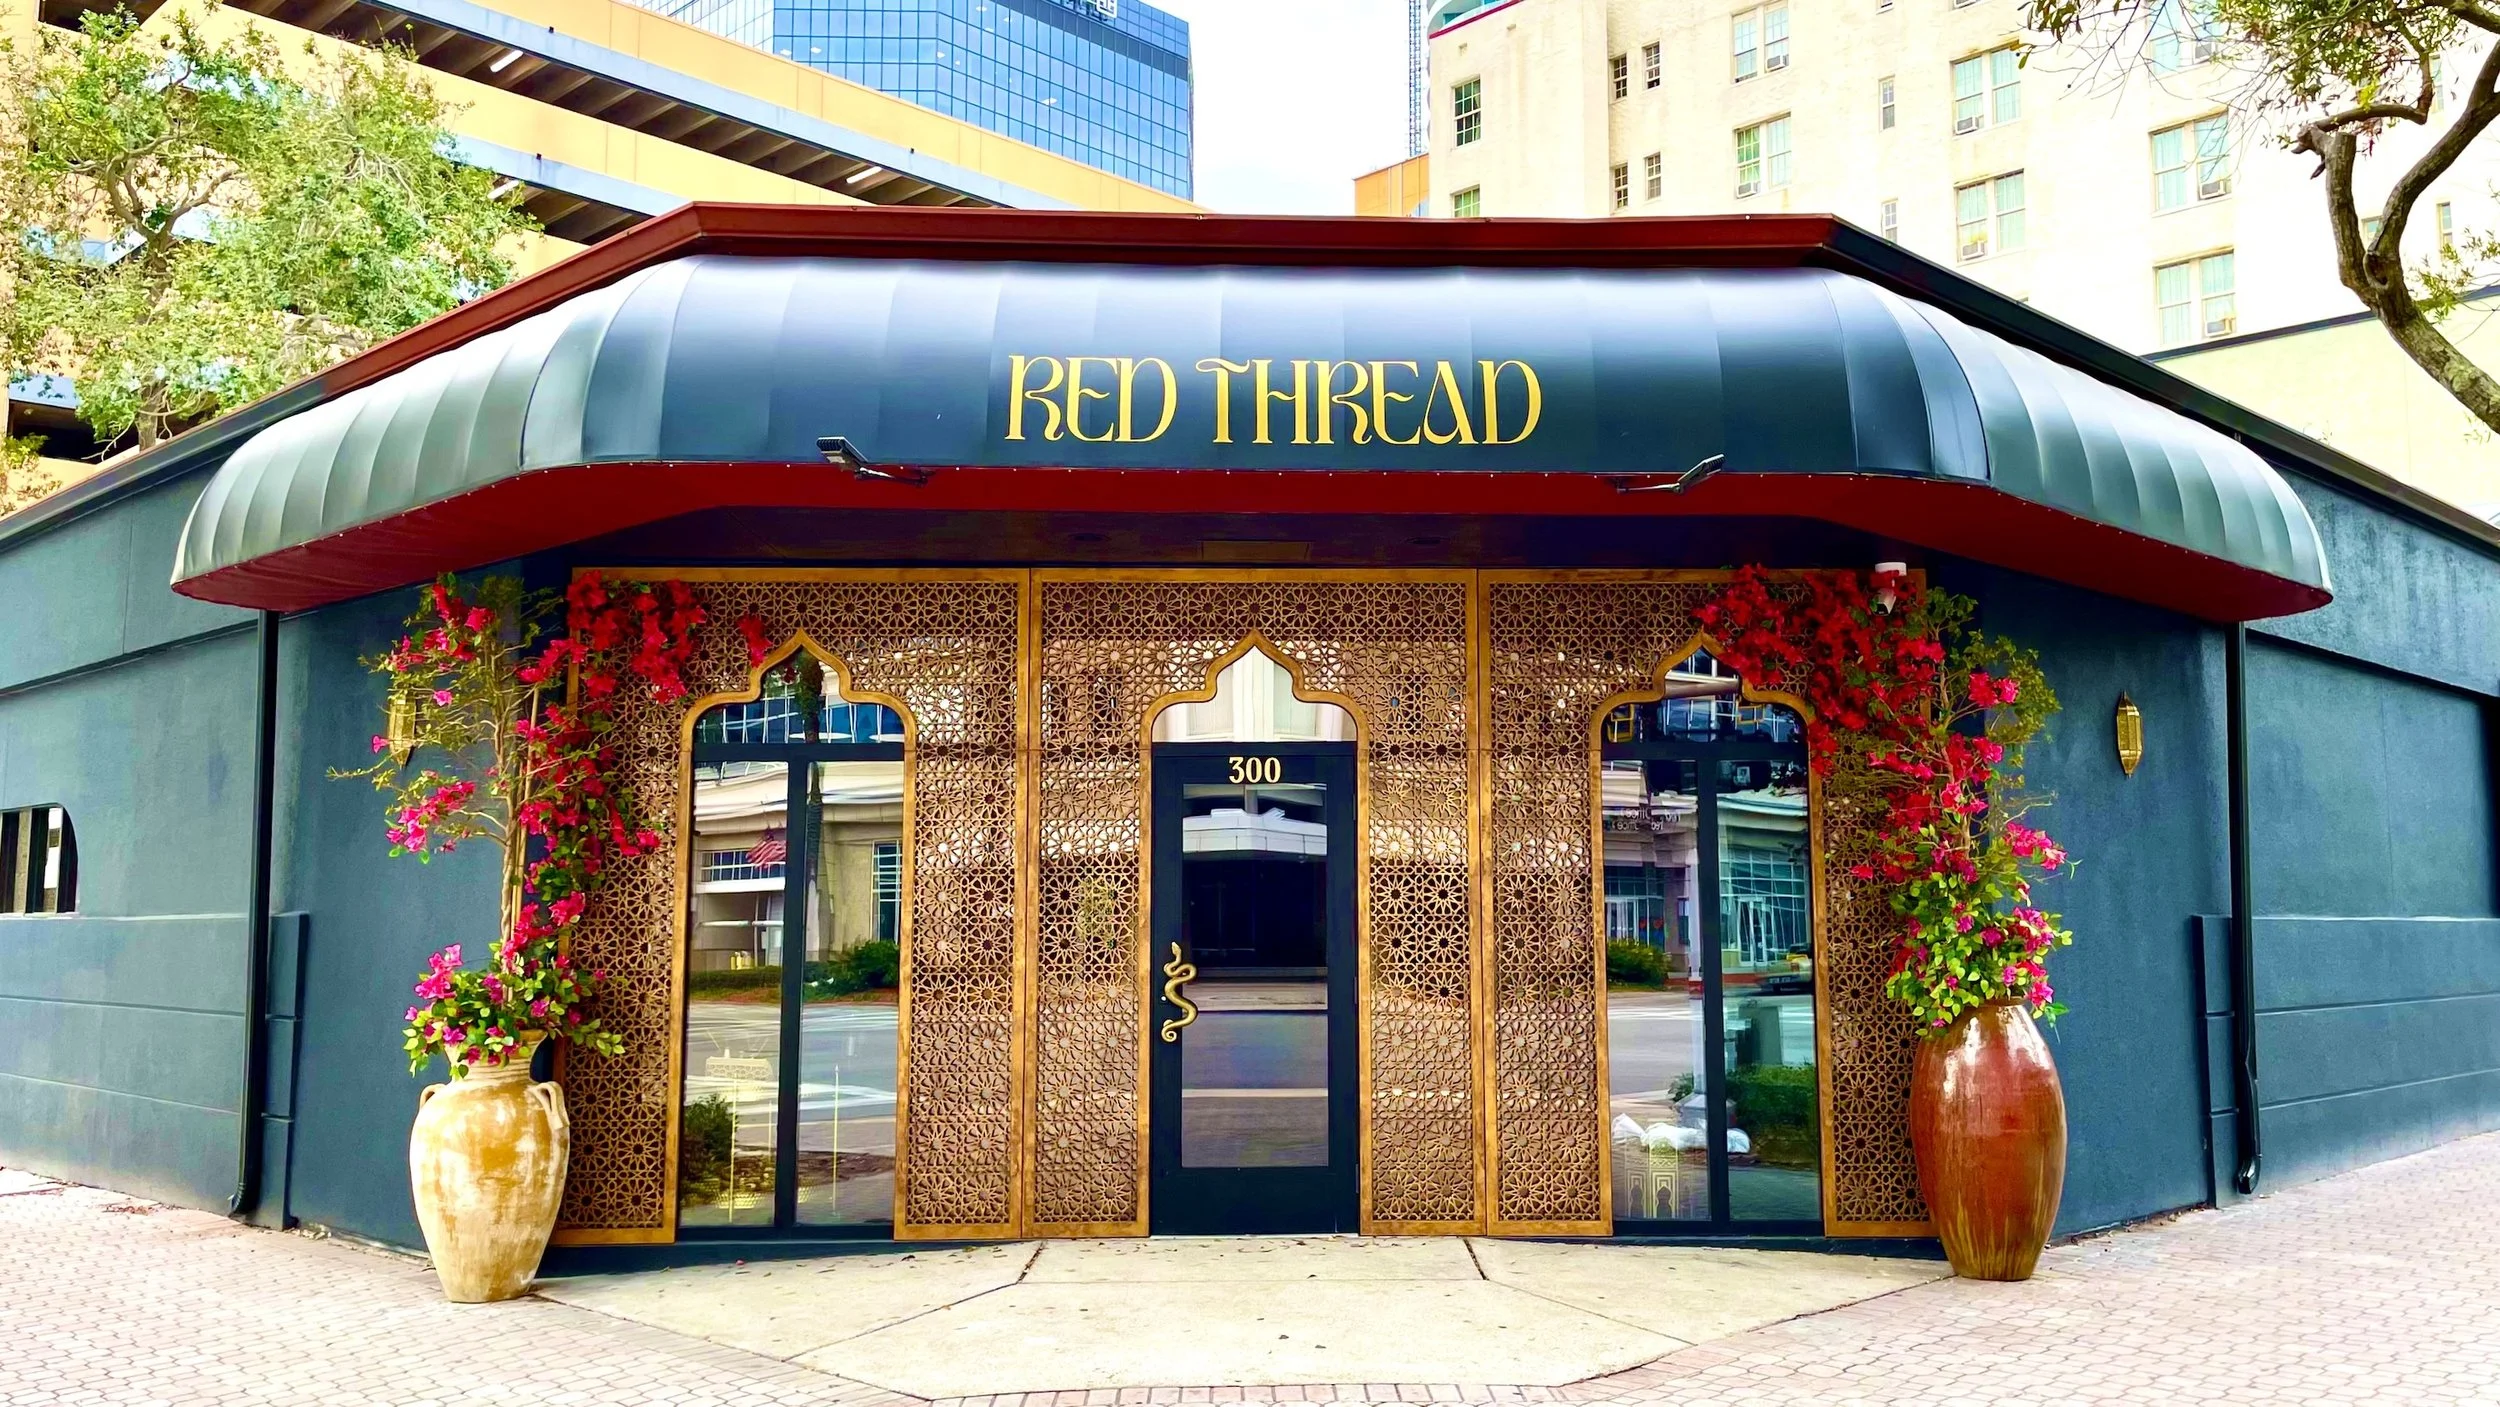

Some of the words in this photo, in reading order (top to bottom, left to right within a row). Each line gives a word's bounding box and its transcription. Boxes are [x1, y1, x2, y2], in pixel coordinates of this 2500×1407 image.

[1004, 354, 1178, 443] RED
[1195, 358, 1543, 446] THREAD
[1228, 756, 1281, 784] 300
